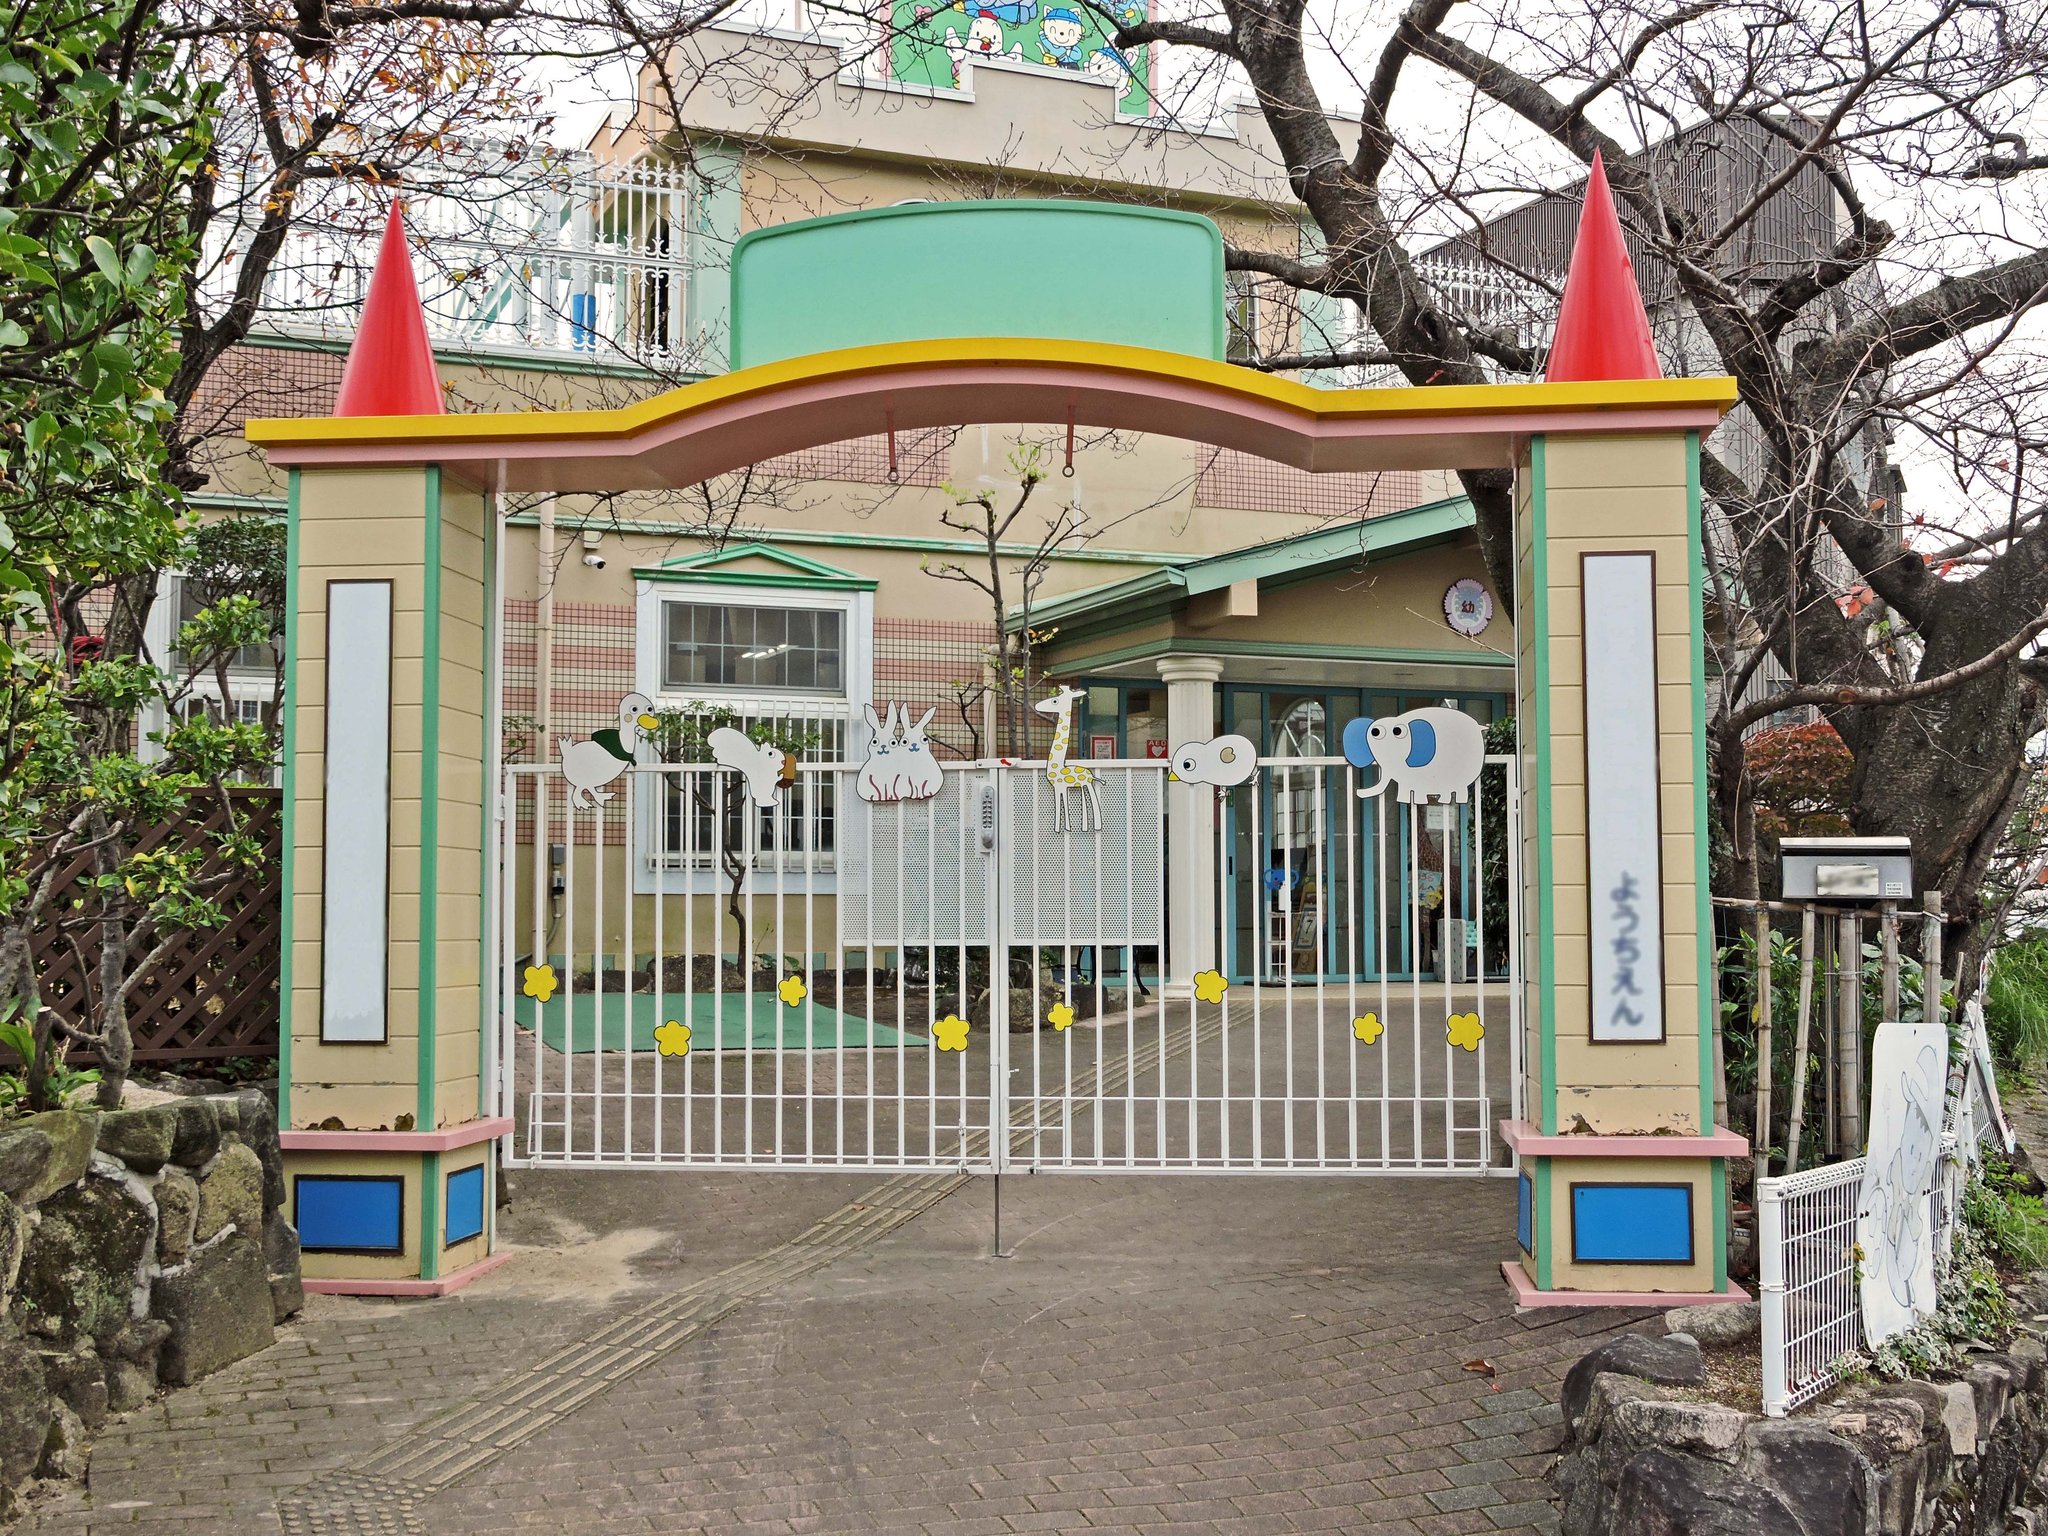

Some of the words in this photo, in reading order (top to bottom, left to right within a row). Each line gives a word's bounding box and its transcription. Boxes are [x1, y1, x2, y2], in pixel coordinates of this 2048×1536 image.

[1461, 600, 1475, 614] 幼
[1610, 870, 1644, 1027] ようちえん
